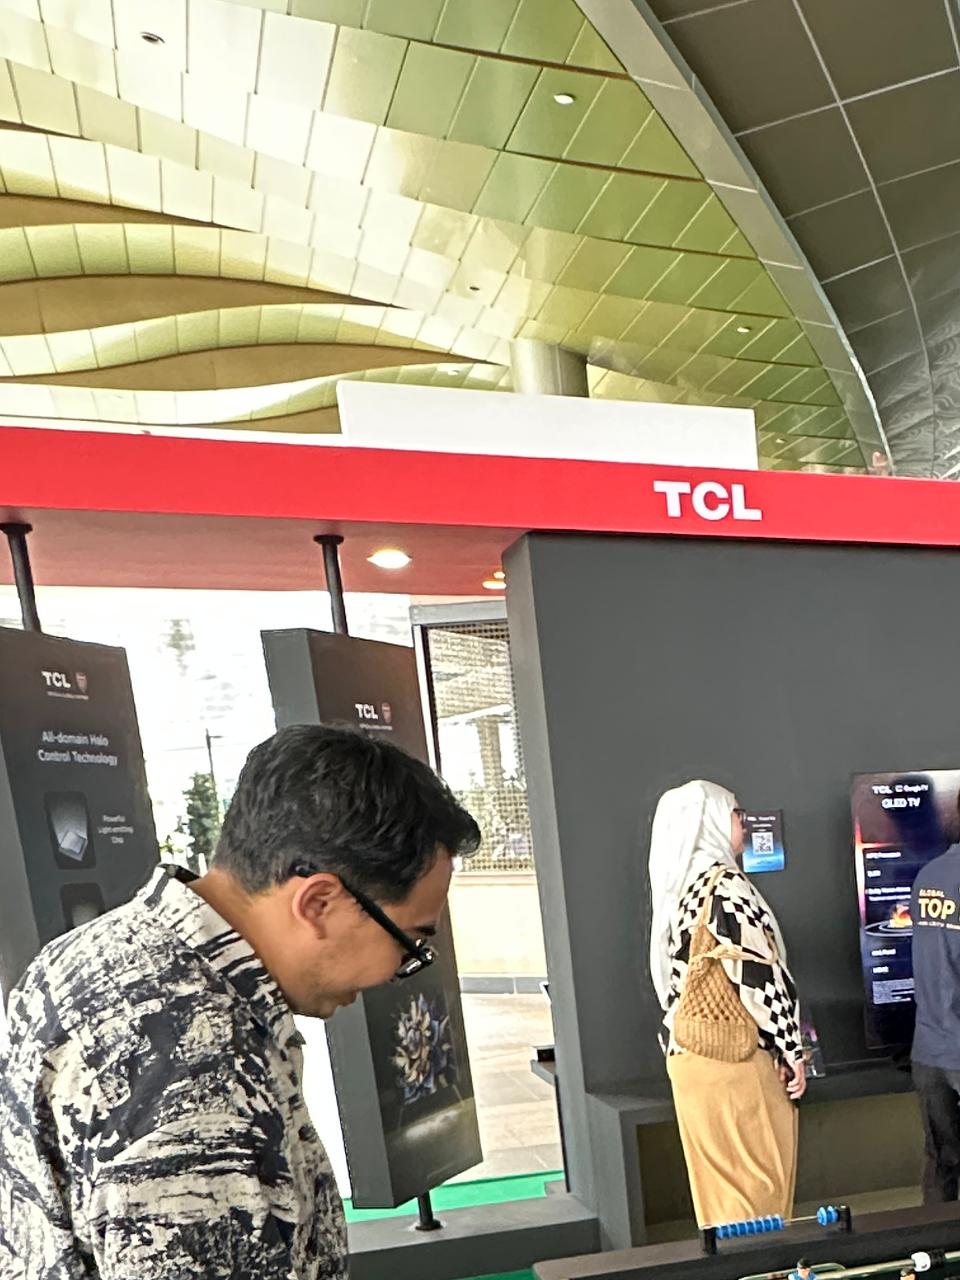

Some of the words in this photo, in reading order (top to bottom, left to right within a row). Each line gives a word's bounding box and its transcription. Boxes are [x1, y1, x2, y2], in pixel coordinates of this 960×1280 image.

[653, 480, 763, 521] TCL
[41, 671, 72, 688] TCL
[355, 703, 379, 720] TCL
[38, 749, 71, 762] Control
[71, 750, 118, 766] Technology
[907, 797, 921, 807] TV
[918, 898, 956, 920] TOP
